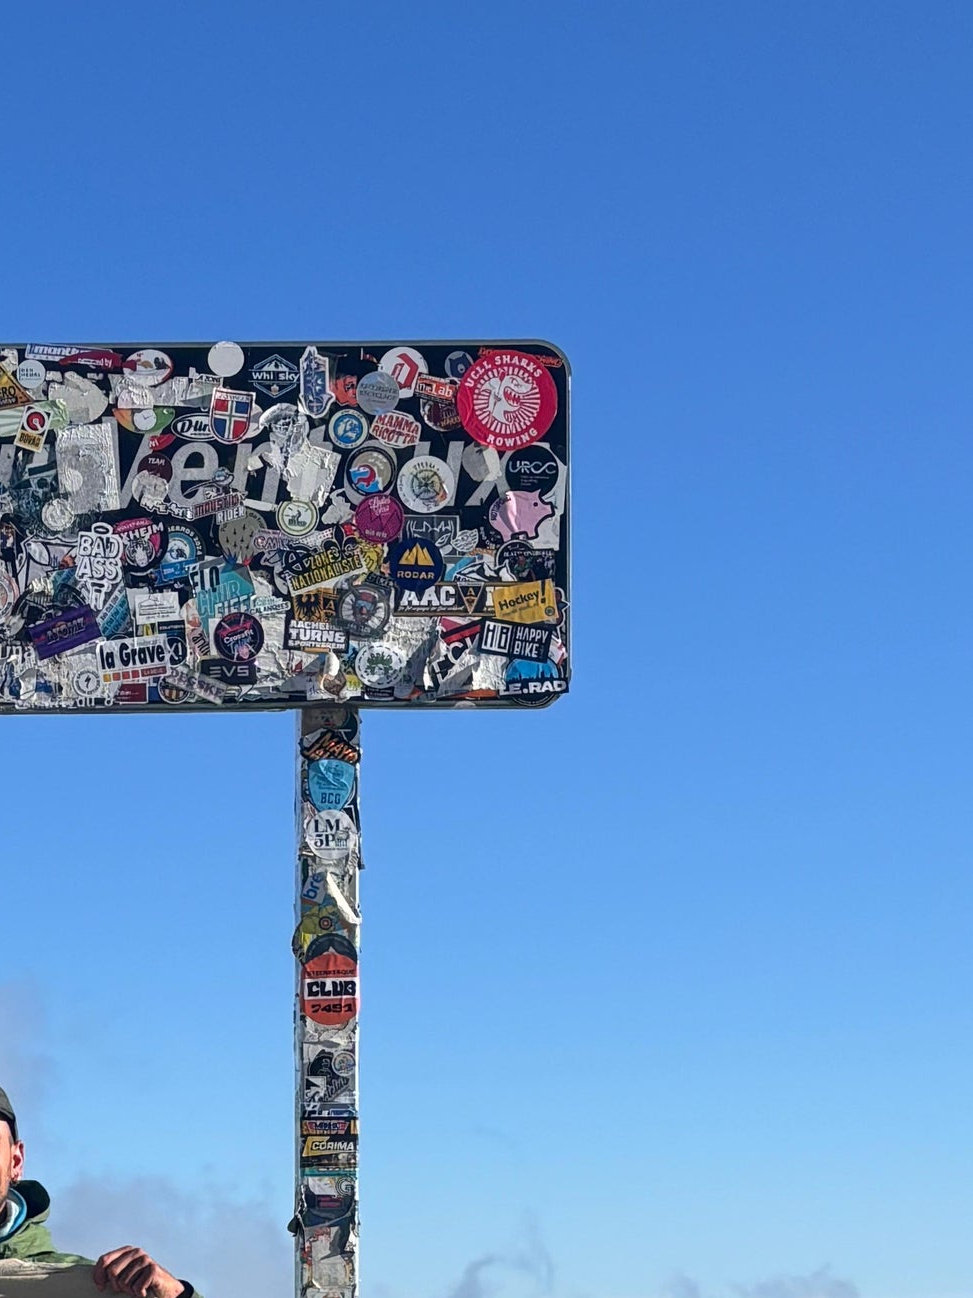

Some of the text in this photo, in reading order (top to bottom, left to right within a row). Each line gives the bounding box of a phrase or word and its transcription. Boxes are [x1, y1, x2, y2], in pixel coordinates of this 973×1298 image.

[464, 354, 543, 388] UCLL SHARKS
[377, 414, 420, 435] MAMMA
[486, 427, 539, 447] ROWING
[216, 506, 246, 524] RIDER
[78, 535, 120, 559] BAD
[77, 558, 119, 580] ASS
[309, 550, 335, 571] ZONE
[290, 555, 363, 592] NATIONALISTE
[397, 570, 435, 581] RODAR
[399, 586, 456, 606] AAC
[499, 579, 547, 611] Hockey!
[515, 625, 549, 644] HAPPY
[100, 642, 167, 670] la Grave
[513, 640, 539, 659] BIKE
[313, 818, 341, 834] LM
[306, 979, 357, 997] CLUB
[310, 1003, 354, 1015] 7491
[311, 1140, 356, 1152] CORIMA
